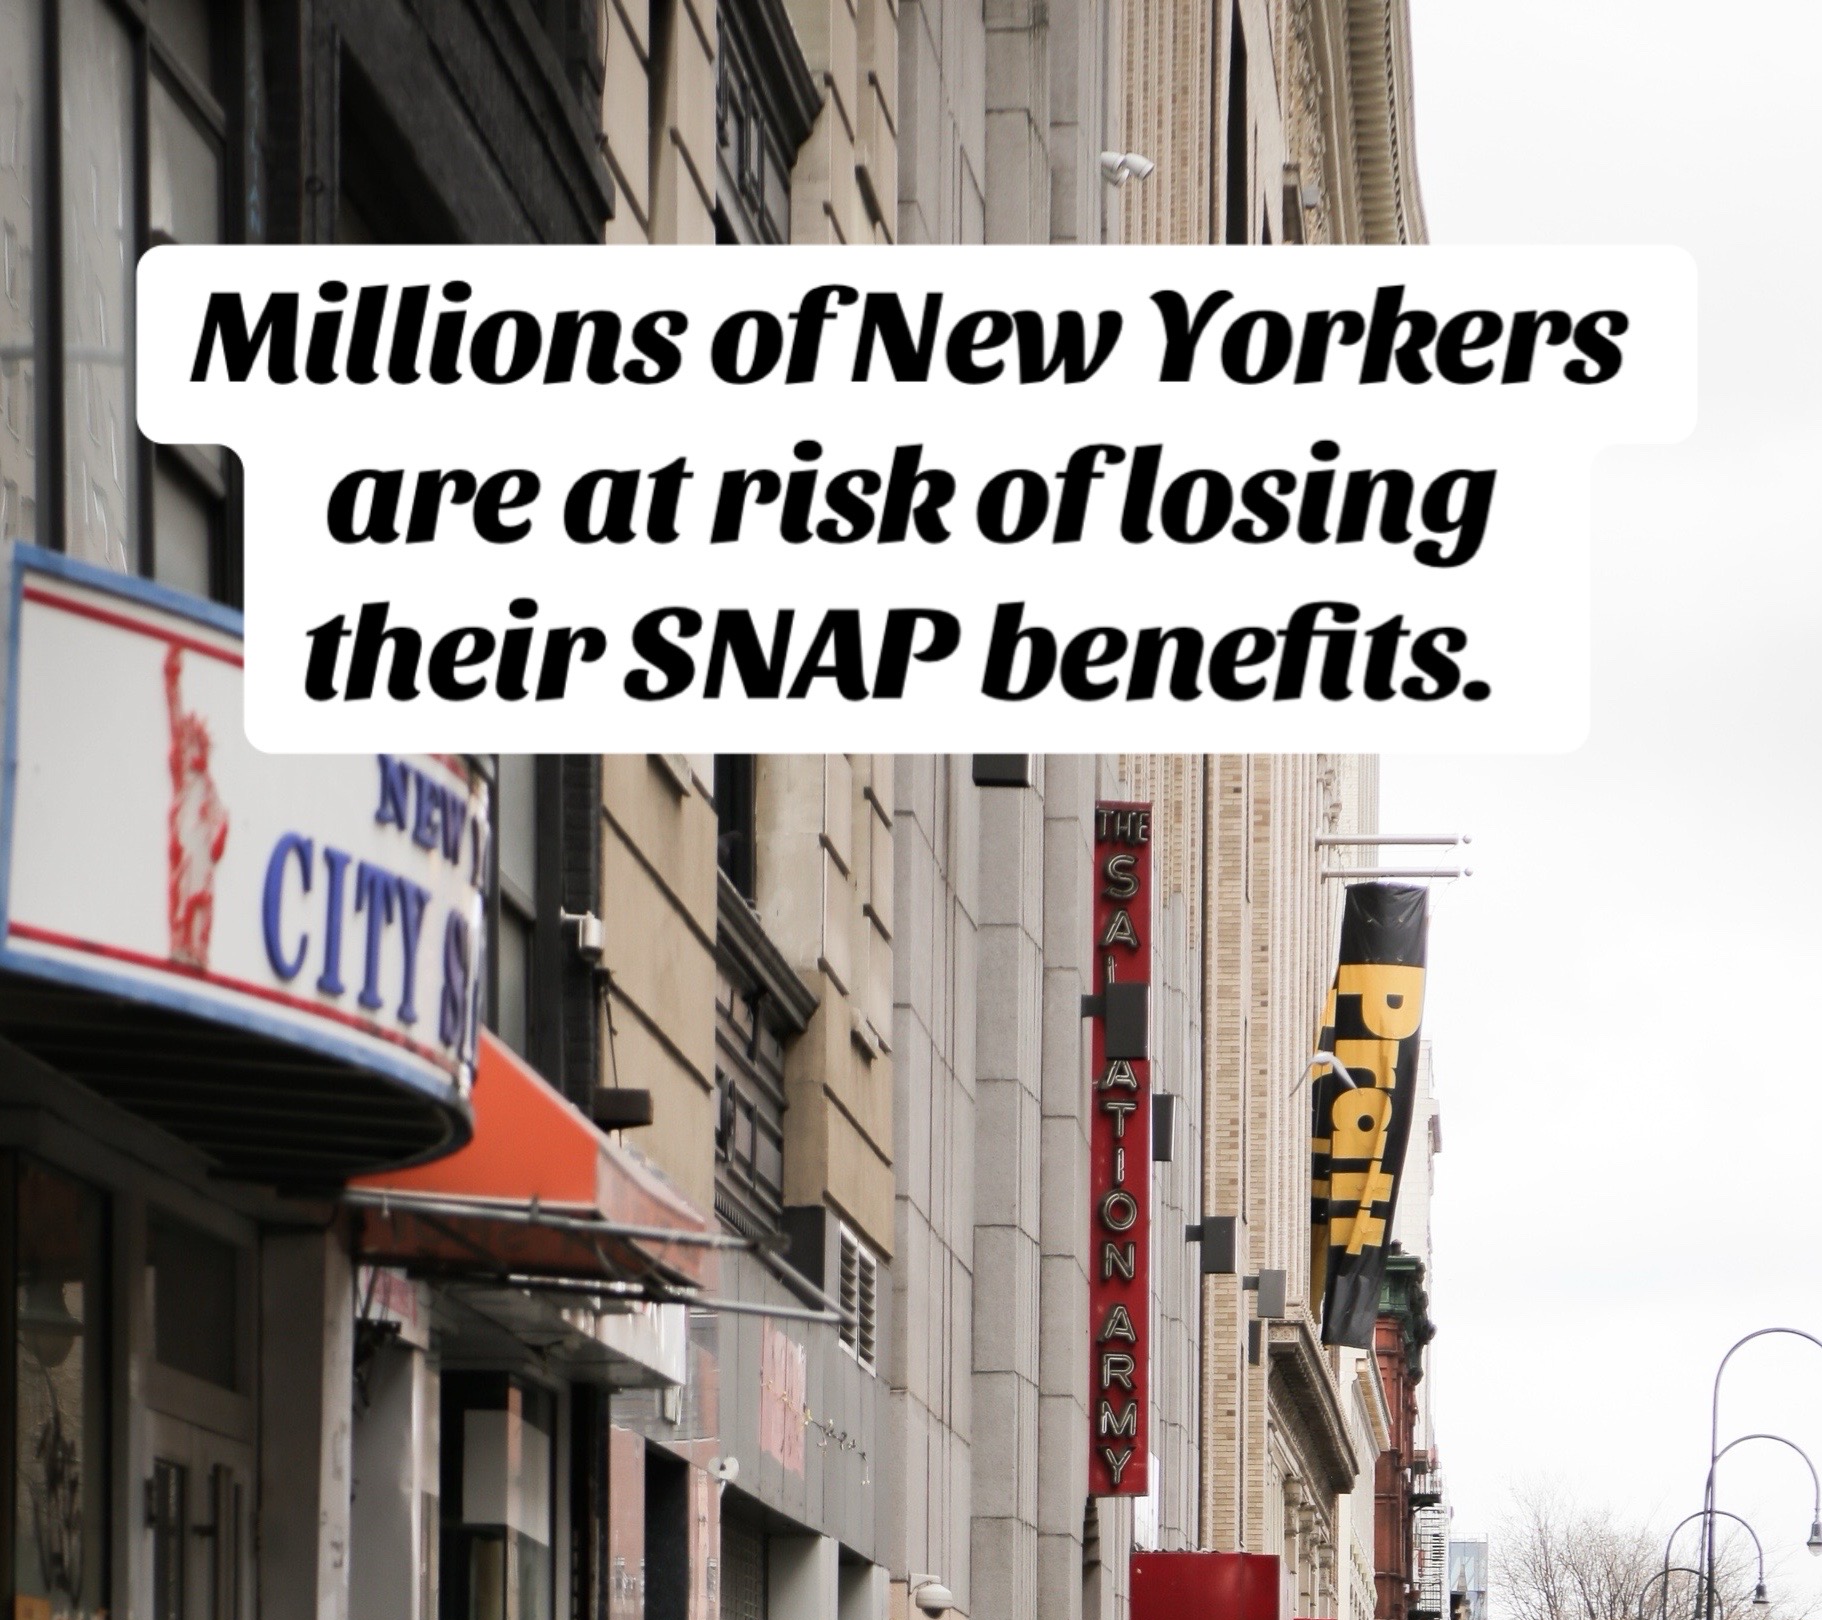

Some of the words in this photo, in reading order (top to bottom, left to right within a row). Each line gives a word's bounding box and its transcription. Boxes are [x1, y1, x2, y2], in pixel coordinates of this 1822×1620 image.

[374, 752, 467, 867] NEW
[1098, 808, 1150, 842] THE
[262, 832, 430, 1026] CITY
[1102, 853, 1141, 1281] SAATION
[1329, 963, 1426, 1256] Pratt
[1100, 1303, 1138, 1488] ARMY
